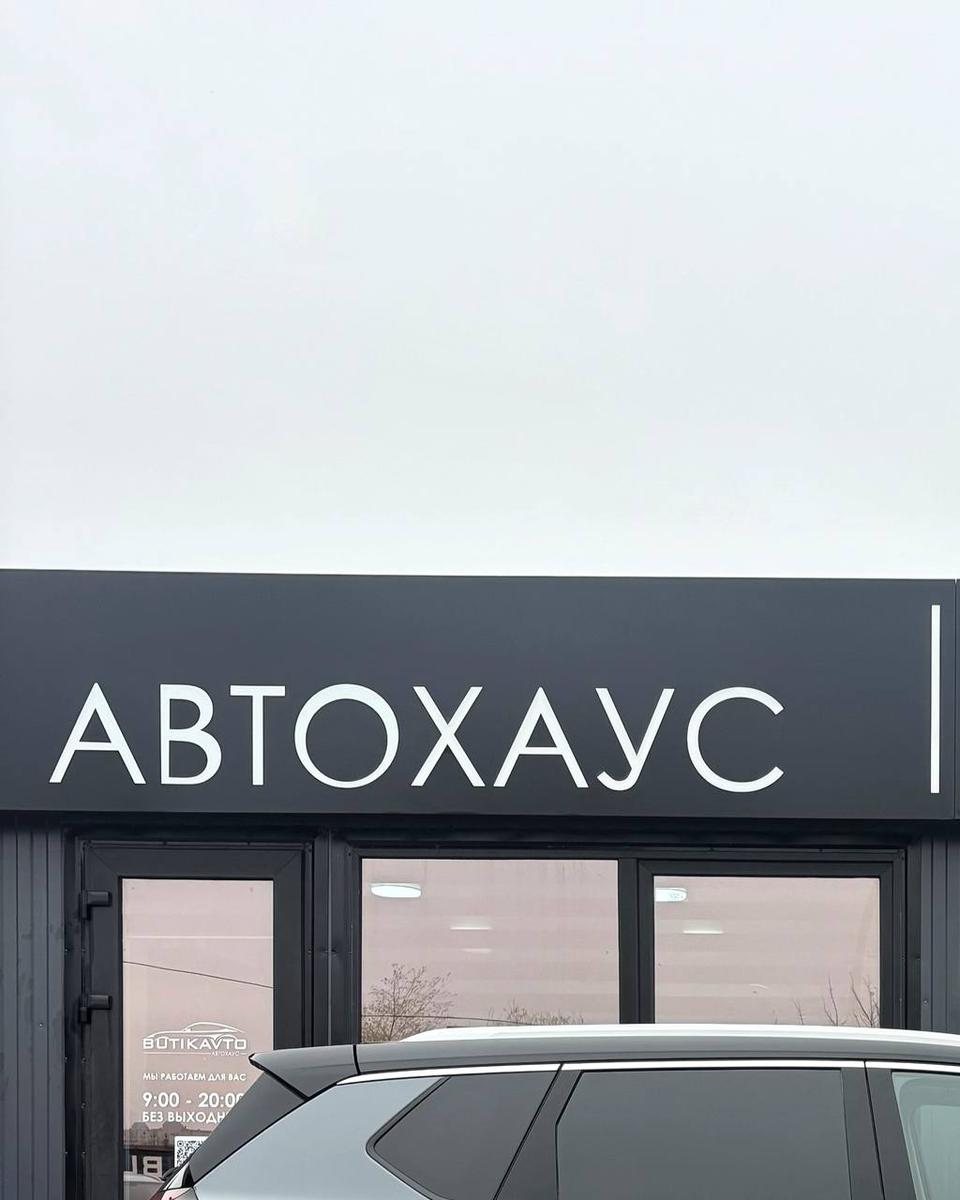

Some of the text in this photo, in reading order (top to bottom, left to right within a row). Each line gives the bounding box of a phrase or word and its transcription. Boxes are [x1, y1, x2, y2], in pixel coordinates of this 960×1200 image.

[49, 681, 785, 793] АВТОХАУС
[143, 1038, 247, 1050] BUTIKAVTO
[143, 1072, 247, 1082] МЫ РАБОТАЕМ ДЛЯ ВАС
[142, 1091, 180, 1108] 9:00
[142, 1111, 229, 1124] БЕЗ ВЫХОДН
